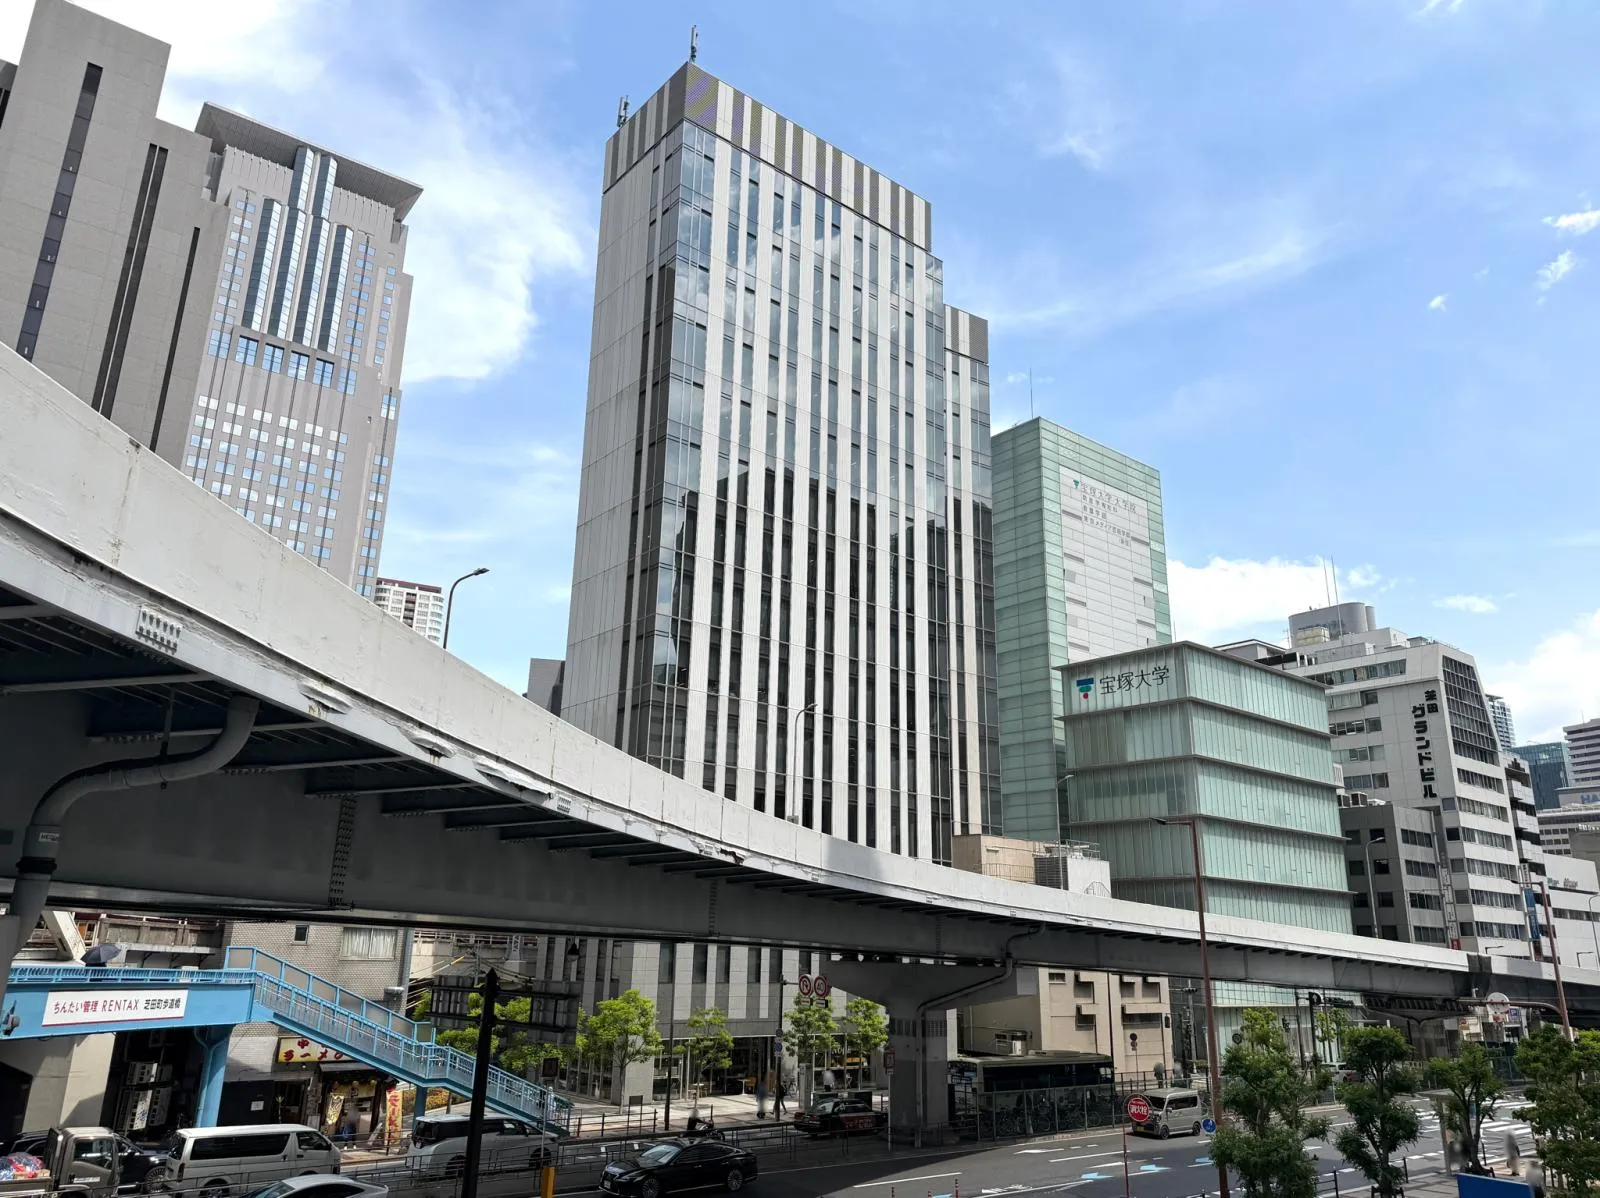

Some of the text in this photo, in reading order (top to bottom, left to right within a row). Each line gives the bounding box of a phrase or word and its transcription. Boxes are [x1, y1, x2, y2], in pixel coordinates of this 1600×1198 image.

[1100, 665, 1169, 694] 宝塚大学
[1411, 703, 1437, 798] グランドビル
[54, 998, 181, 1014] ちんたい管理 RENTAX 芝田町歩道橋
